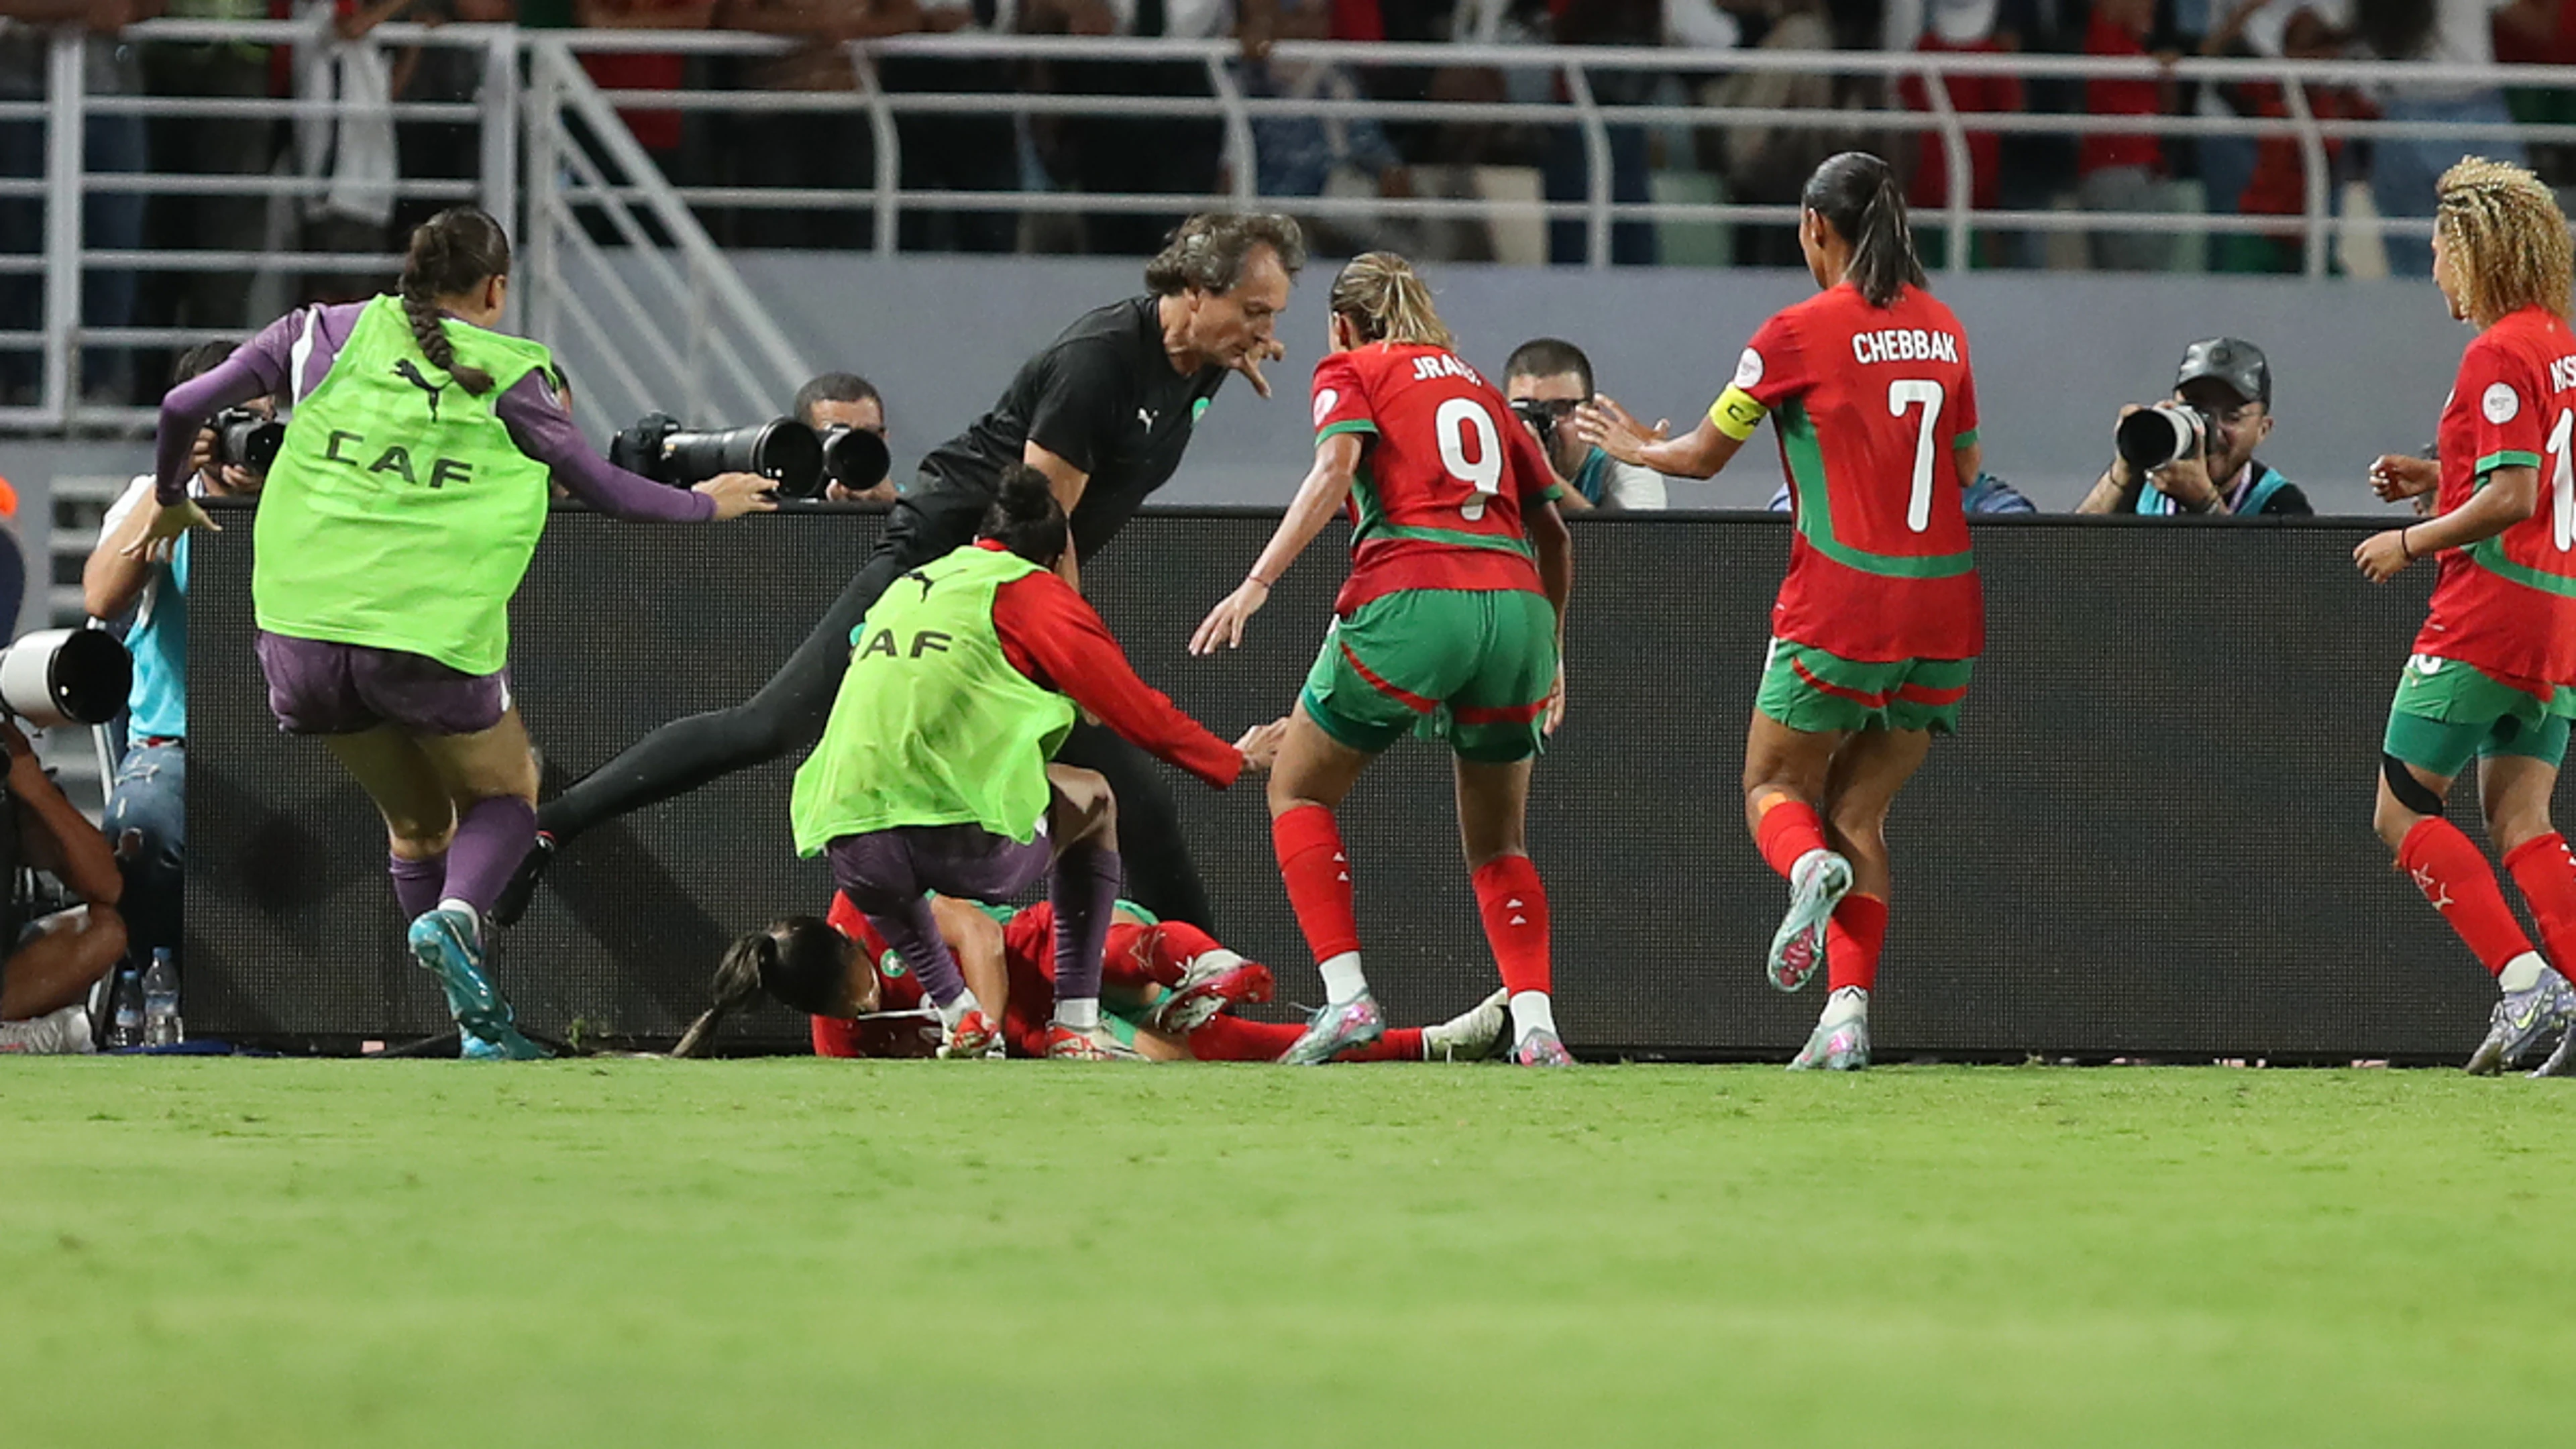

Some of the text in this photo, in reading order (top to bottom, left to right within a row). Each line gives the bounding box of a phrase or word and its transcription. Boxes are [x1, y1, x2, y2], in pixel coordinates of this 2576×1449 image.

[1852, 329, 1958, 364] CHEBBAK
[326, 429, 473, 488] CAF
[1436, 397, 1501, 521] 9
[1888, 380, 1943, 532] 7
[2546, 407, 2576, 552] 1
[860, 628, 953, 659] AF
